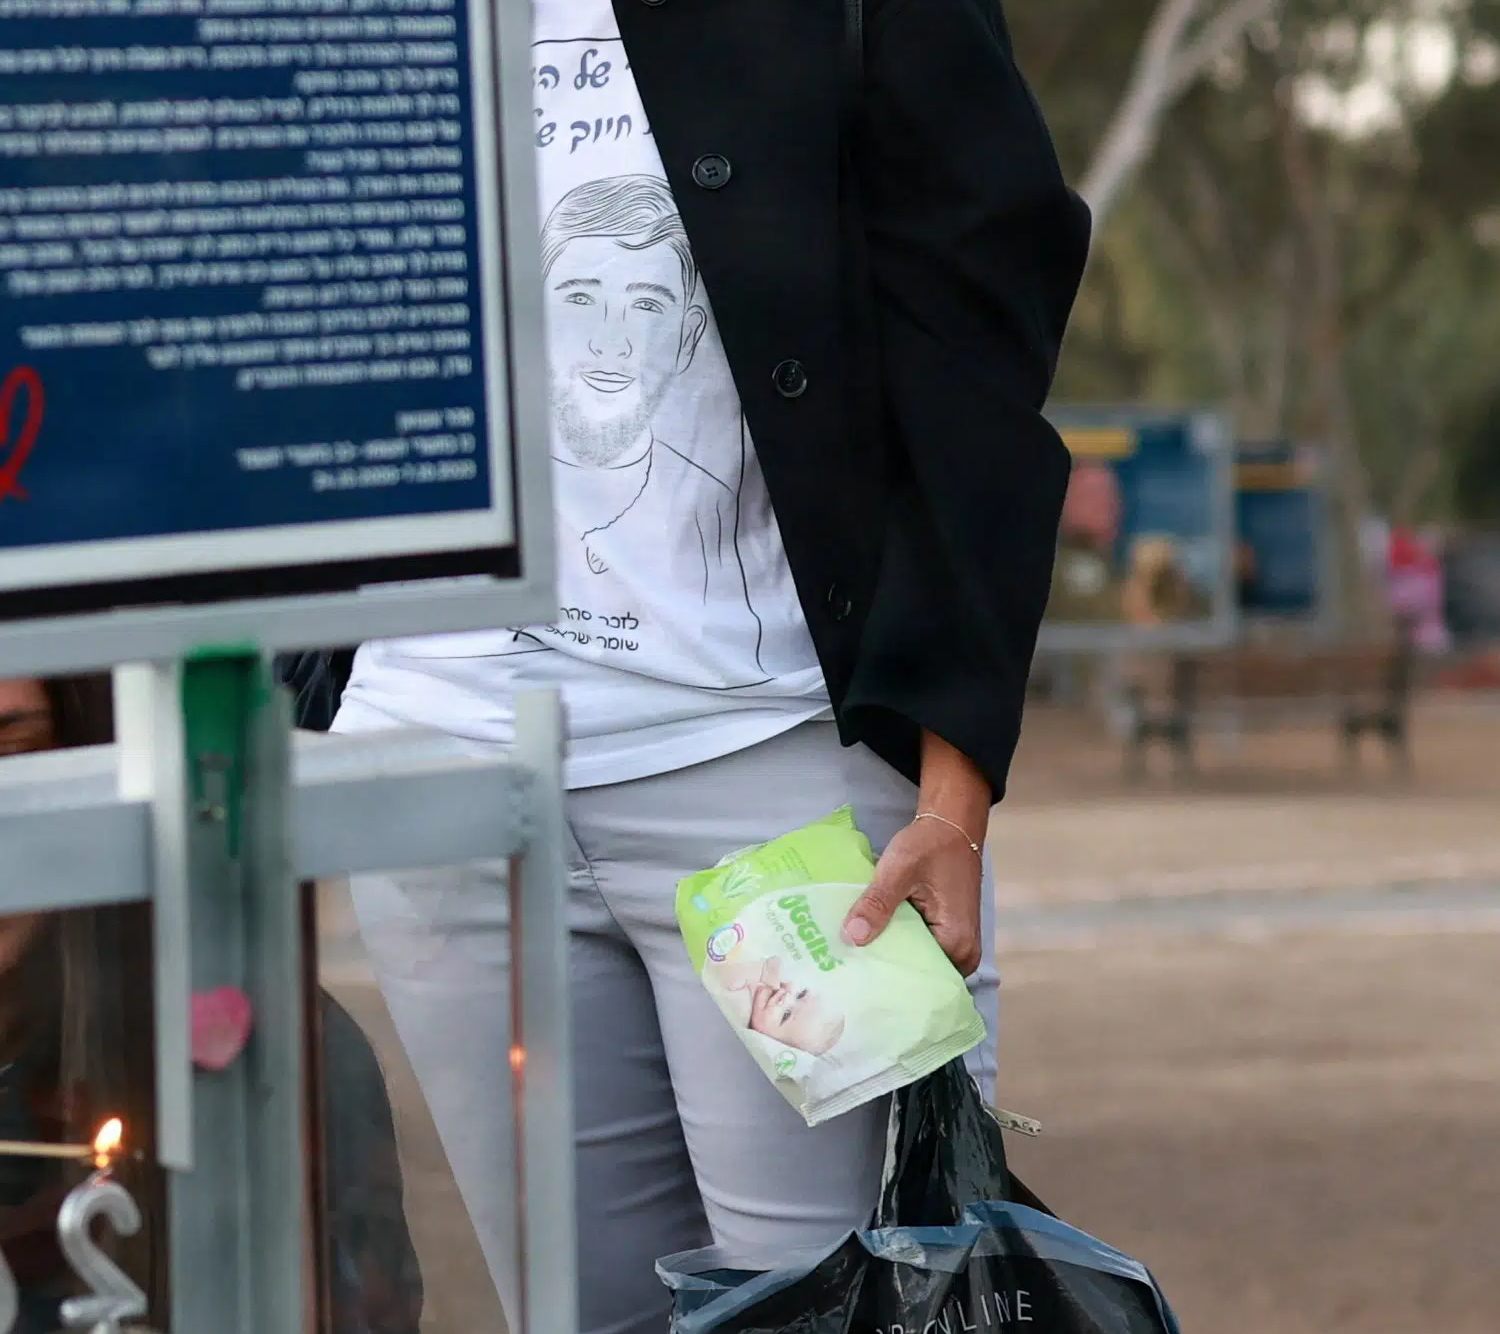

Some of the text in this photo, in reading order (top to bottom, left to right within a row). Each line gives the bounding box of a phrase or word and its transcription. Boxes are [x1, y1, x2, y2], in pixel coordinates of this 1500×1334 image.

[574, 48, 612, 90] של
[560, 607, 639, 630] לזכר סהר
[596, 635, 639, 651] שומר
